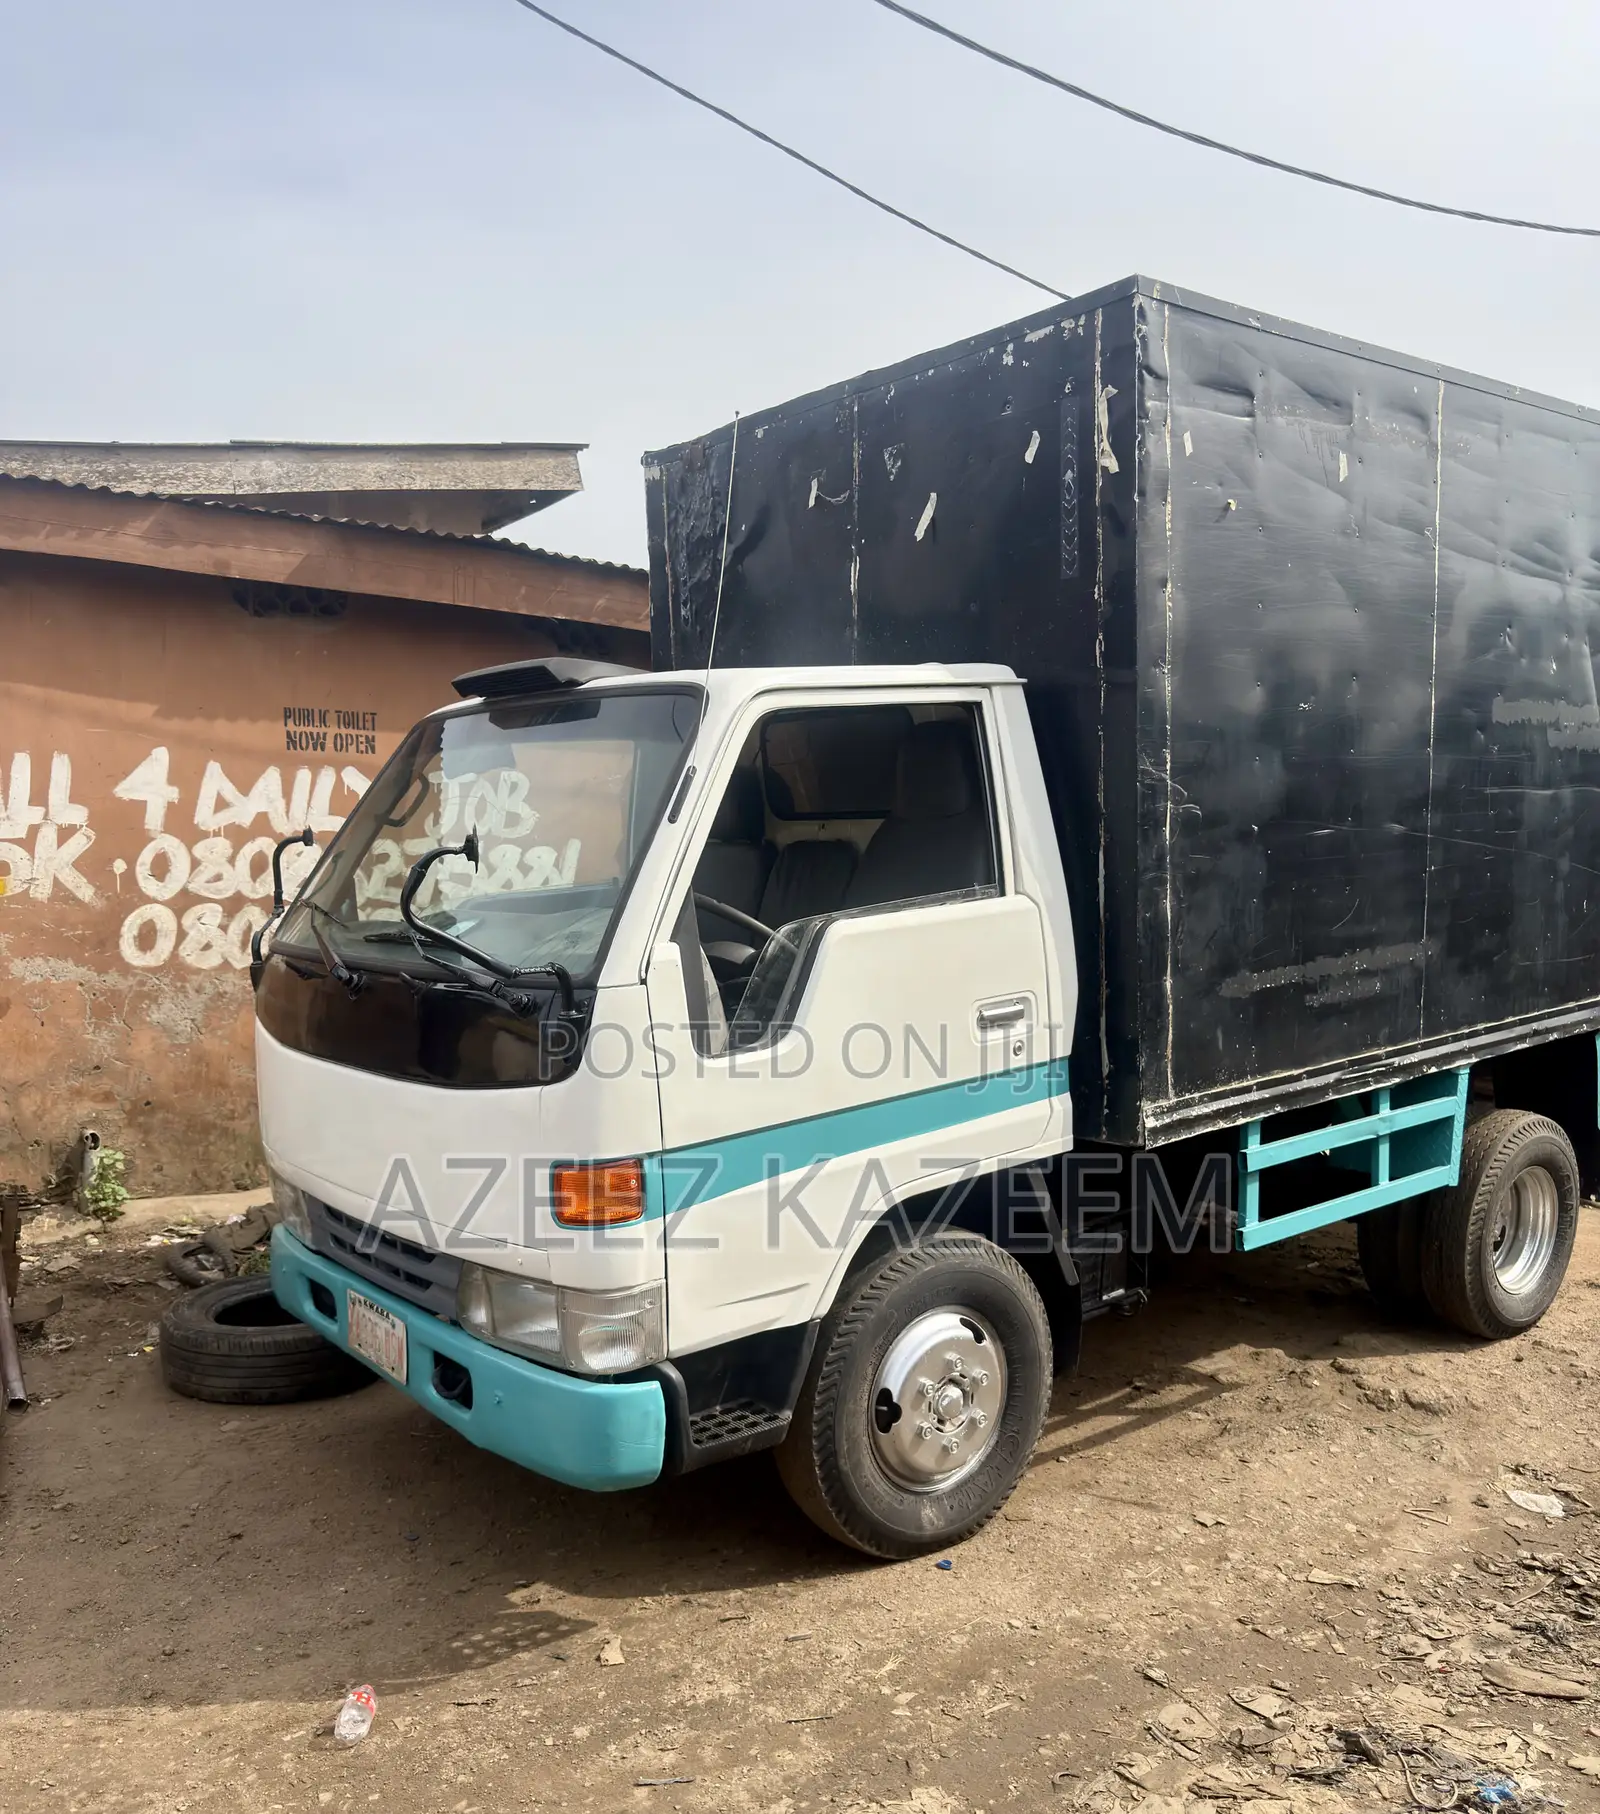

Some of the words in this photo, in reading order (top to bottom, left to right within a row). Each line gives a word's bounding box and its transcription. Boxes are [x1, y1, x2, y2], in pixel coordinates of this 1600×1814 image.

[283, 706, 331, 729] PUBLIC
[335, 710, 378, 732] TOILET
[285, 729, 328, 752] NOW
[333, 732, 376, 755] OPEN
[113, 746, 180, 836] 4
[424, 770, 541, 839] JOB
